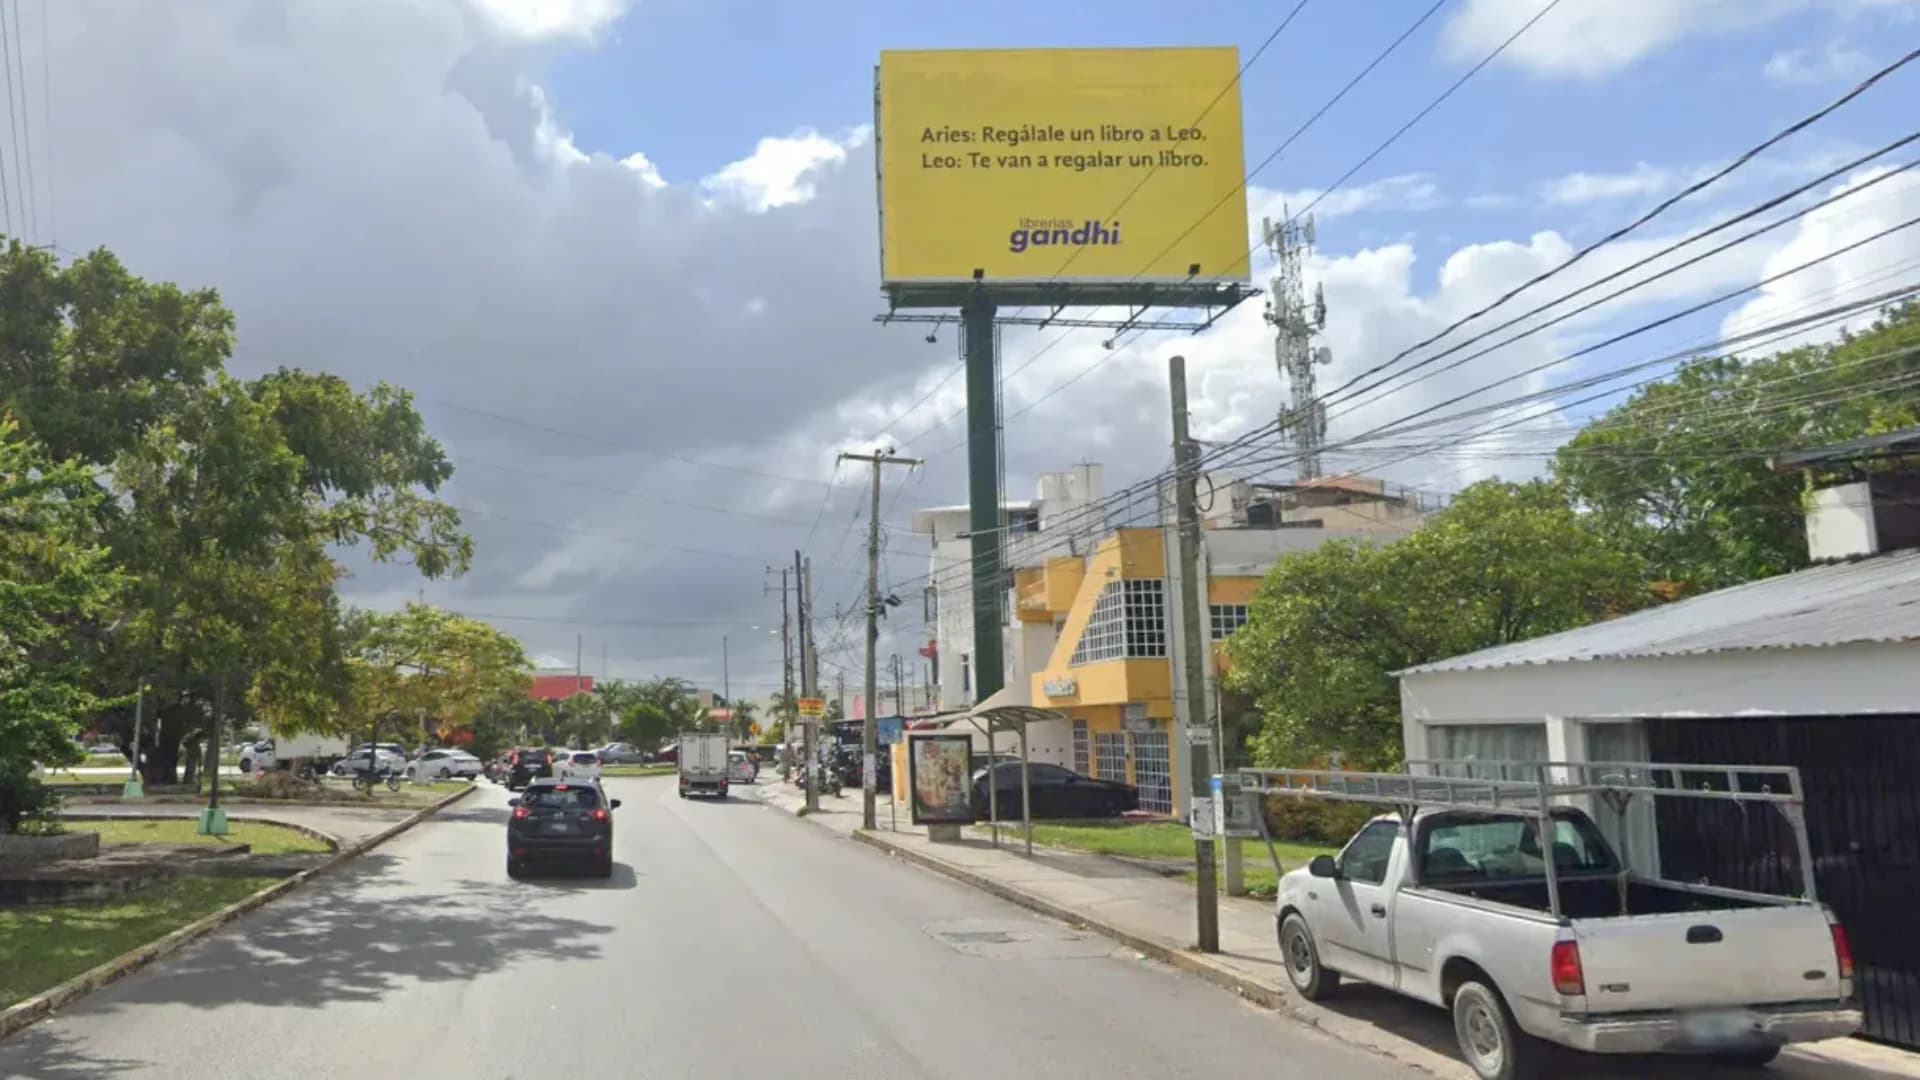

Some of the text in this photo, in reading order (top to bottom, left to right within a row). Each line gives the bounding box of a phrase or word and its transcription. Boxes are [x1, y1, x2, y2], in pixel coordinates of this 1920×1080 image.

[921, 124, 1207, 147] Aries: Regálale un libro a Leo.
[922, 150, 1208, 172] Leo: Te van a regalar un libro.
[1009, 220, 1120, 253] gandhi
